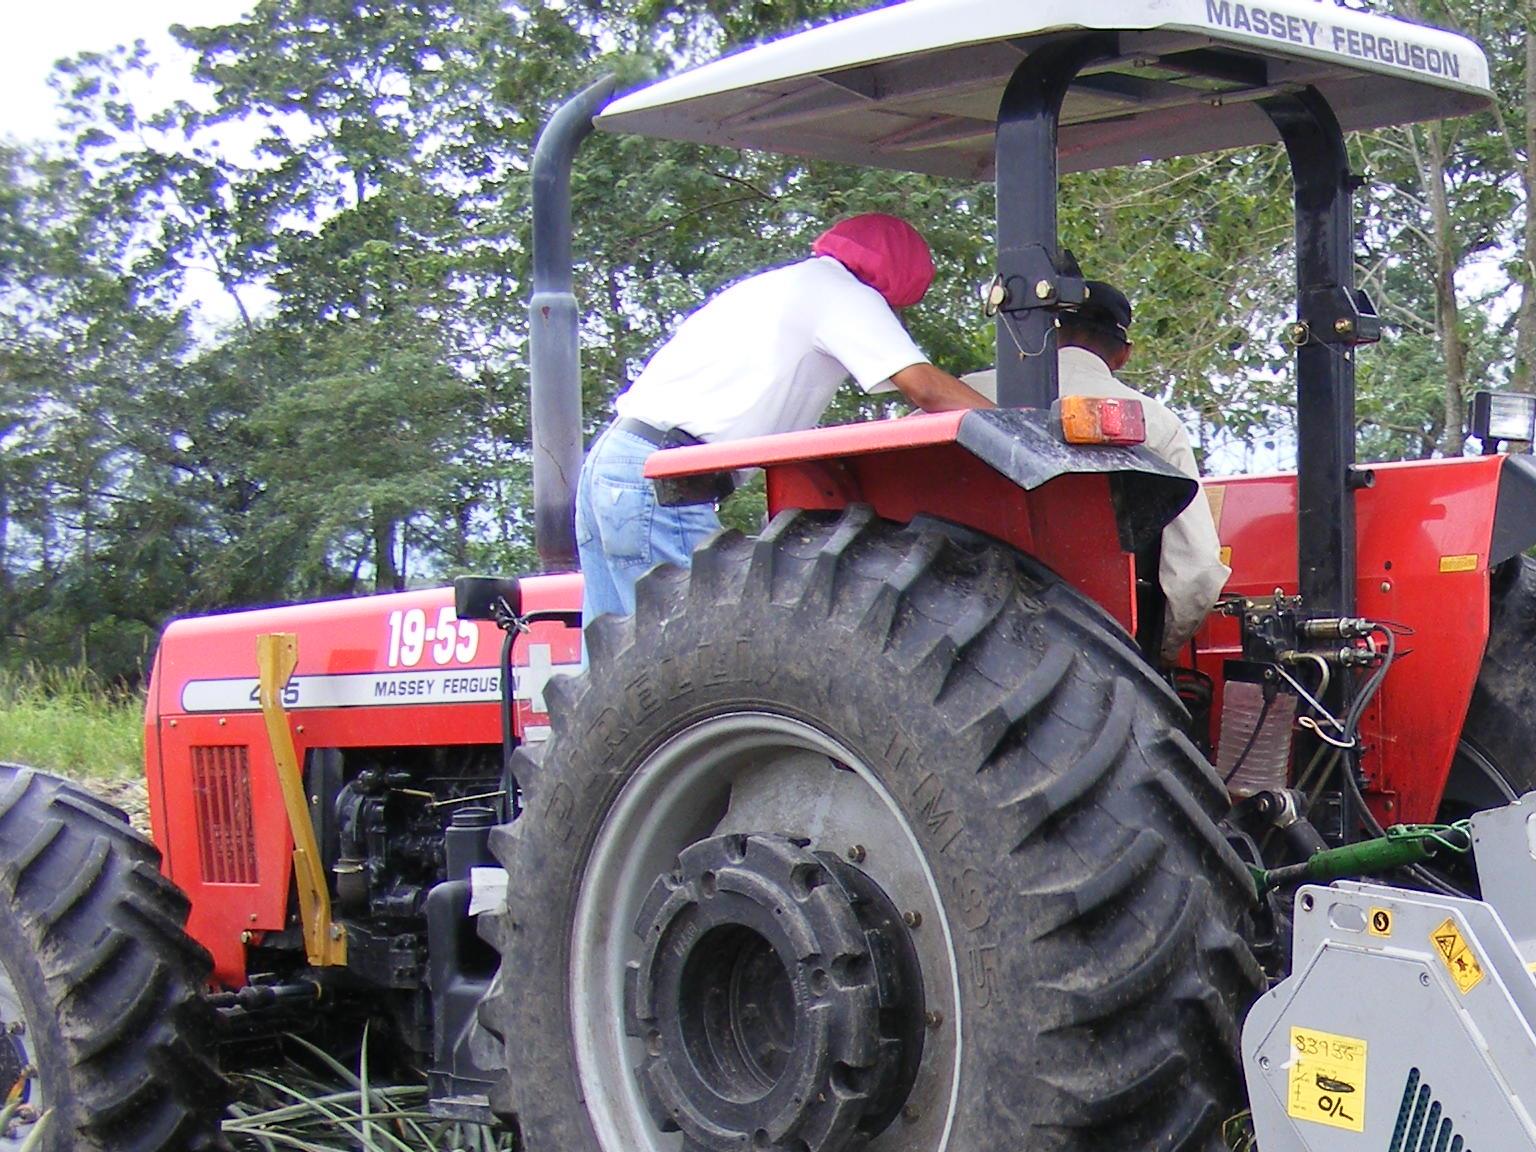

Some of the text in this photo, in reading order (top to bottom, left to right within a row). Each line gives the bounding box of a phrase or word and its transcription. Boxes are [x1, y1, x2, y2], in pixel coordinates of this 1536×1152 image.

[1206, 0, 1460, 79] MASSEY FERGUSON
[387, 606, 479, 668] 19-55
[249, 682, 300, 705] 45
[374, 675, 521, 697] MASSEY FERGUSN
